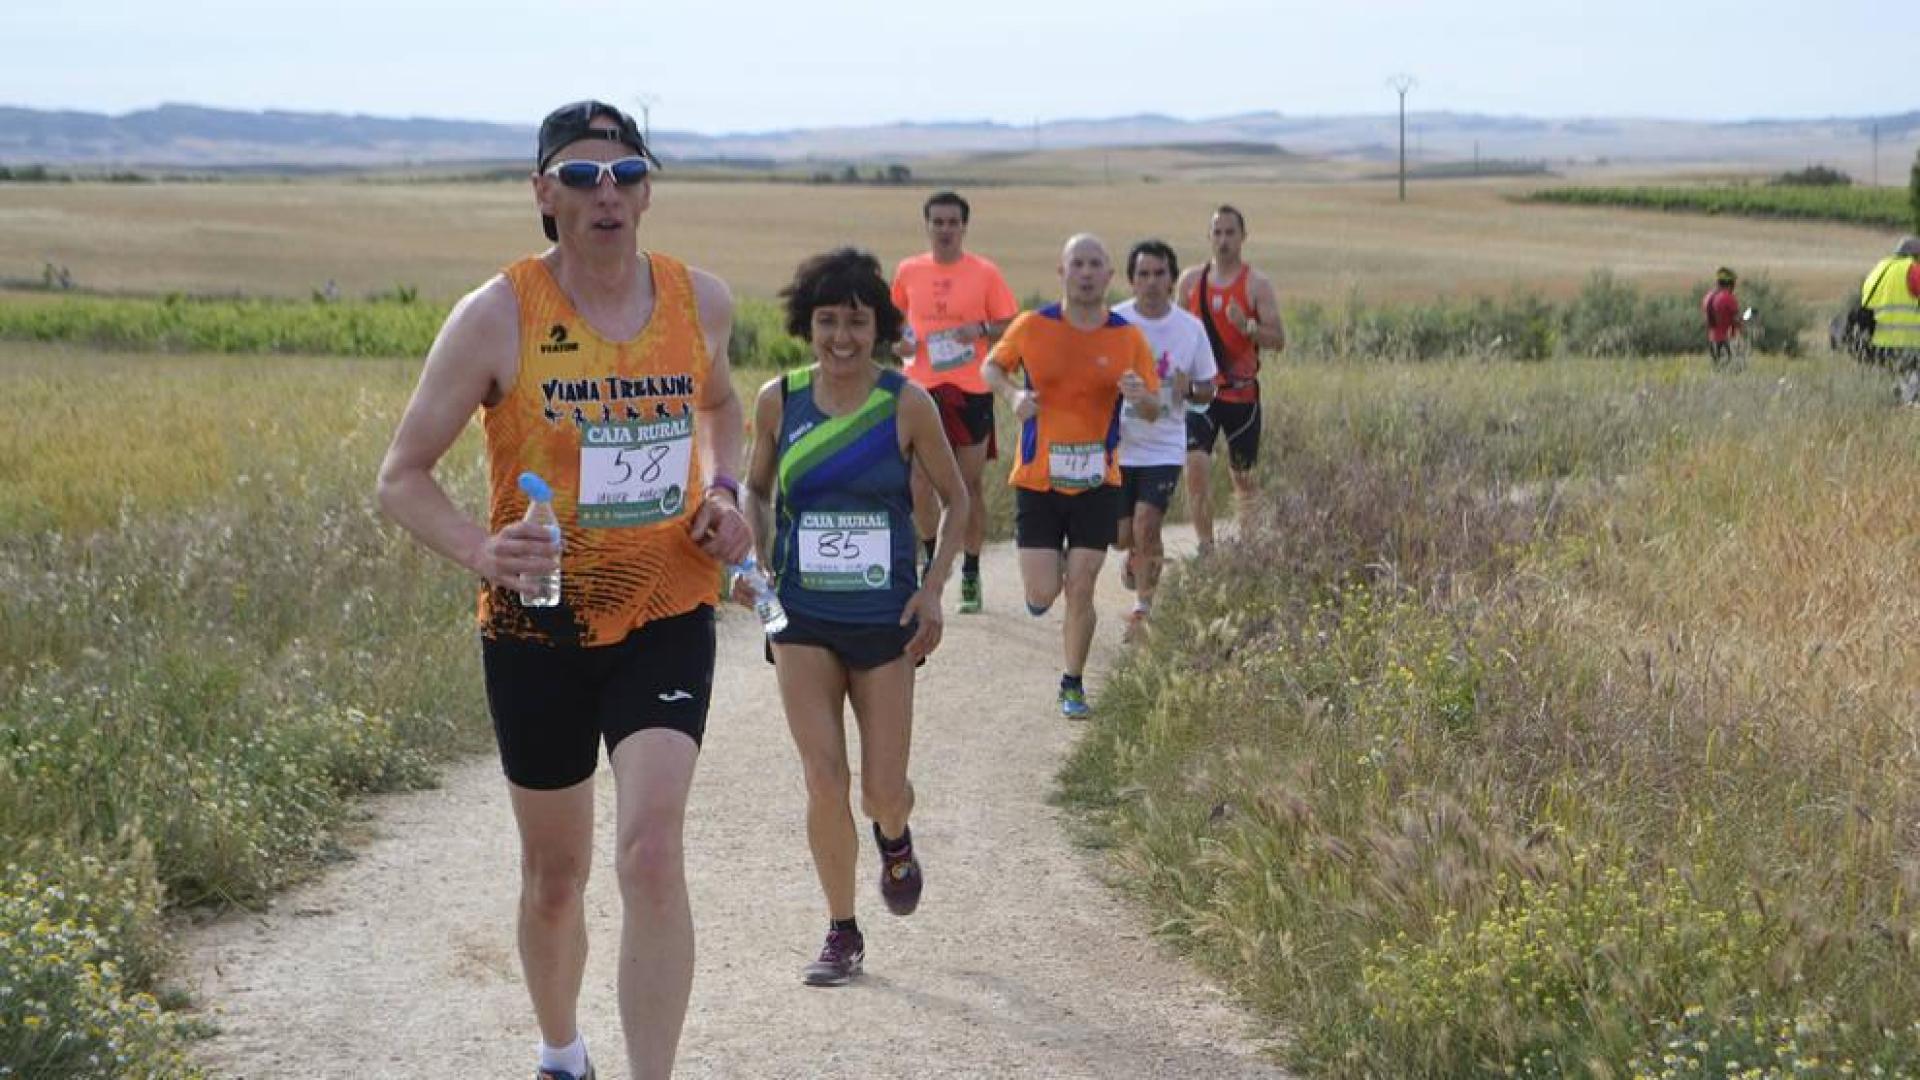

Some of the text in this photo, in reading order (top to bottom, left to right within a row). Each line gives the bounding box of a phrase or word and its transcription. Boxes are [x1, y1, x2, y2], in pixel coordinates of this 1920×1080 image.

[542, 379, 600, 401] VIANA
[588, 419, 690, 442] CAJA RURAL
[606, 445, 669, 485] 58
[803, 514, 885, 529] CAJA RURAL
[818, 530, 869, 559] 85
